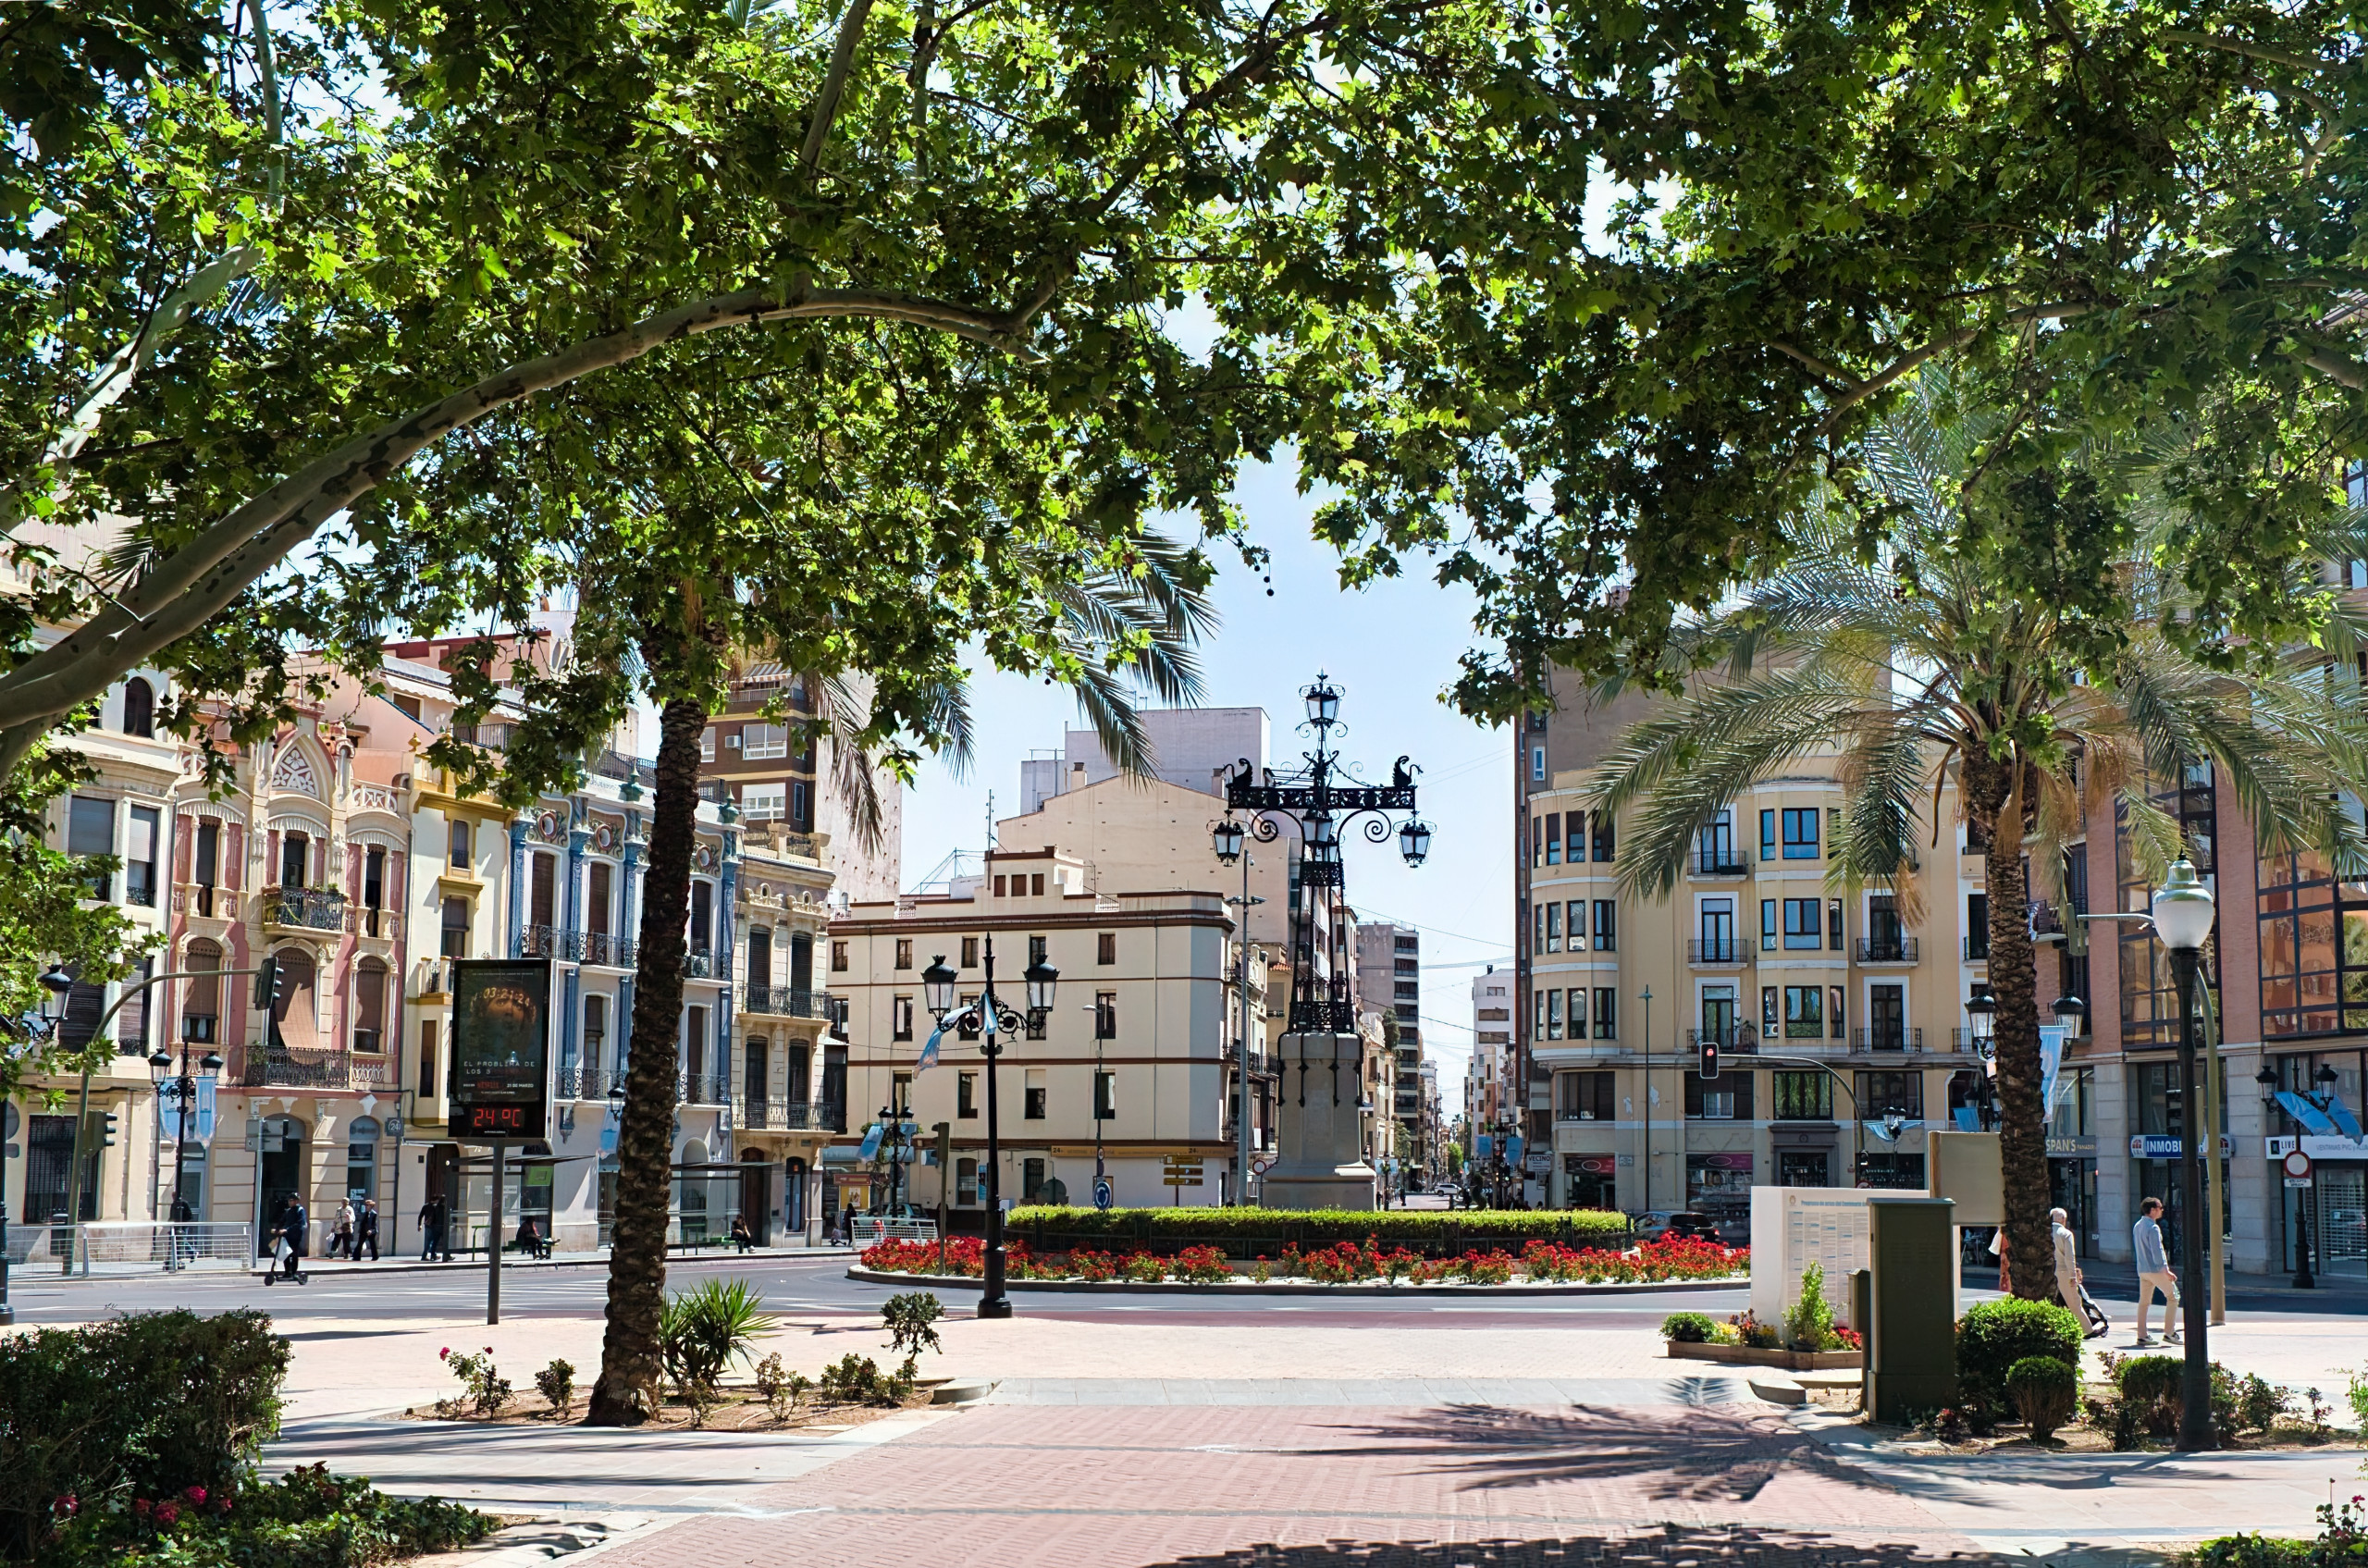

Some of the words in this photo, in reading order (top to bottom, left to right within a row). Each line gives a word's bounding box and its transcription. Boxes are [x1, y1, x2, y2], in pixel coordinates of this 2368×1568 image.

[474, 1108, 495, 1127] 24
[2147, 1141, 2182, 1152] INMOBI
[2281, 1141, 2295, 1149] LIVE
